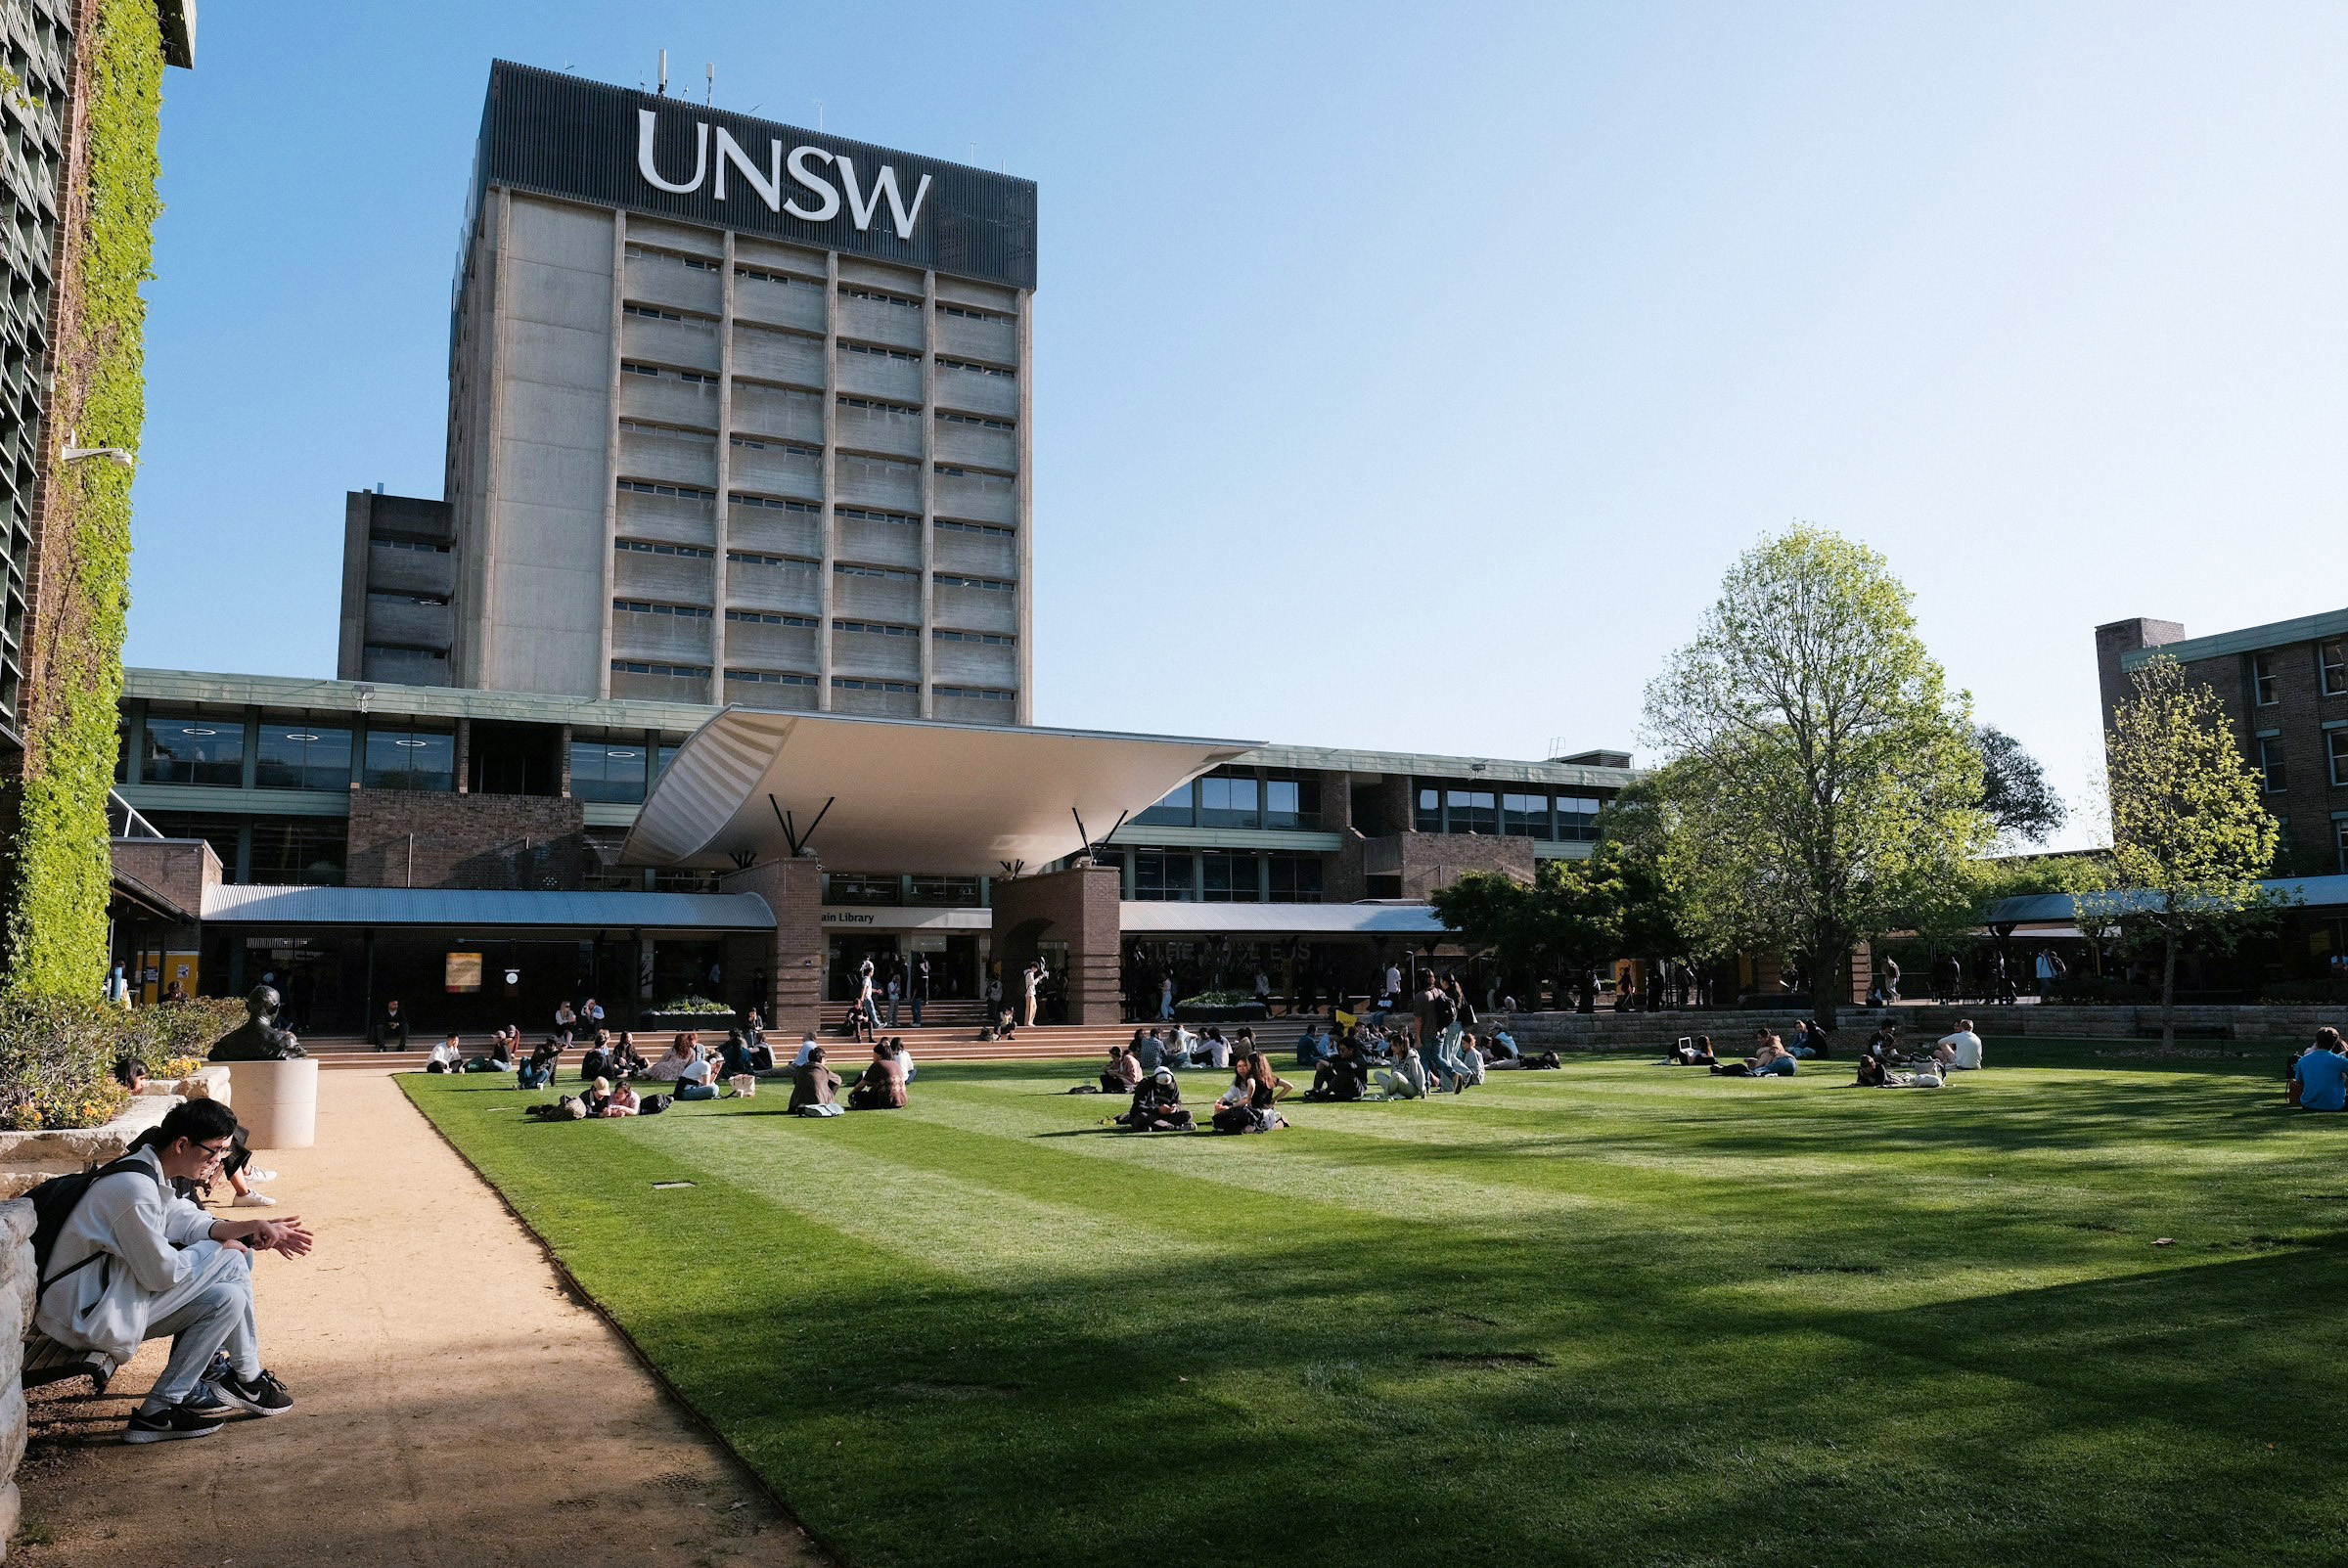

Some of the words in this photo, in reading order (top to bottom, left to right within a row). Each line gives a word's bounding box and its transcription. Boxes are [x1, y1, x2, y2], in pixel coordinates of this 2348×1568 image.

[638, 109, 932, 240] UNSW
[822, 913, 836, 922] ain
[838, 912, 875, 924] Library
